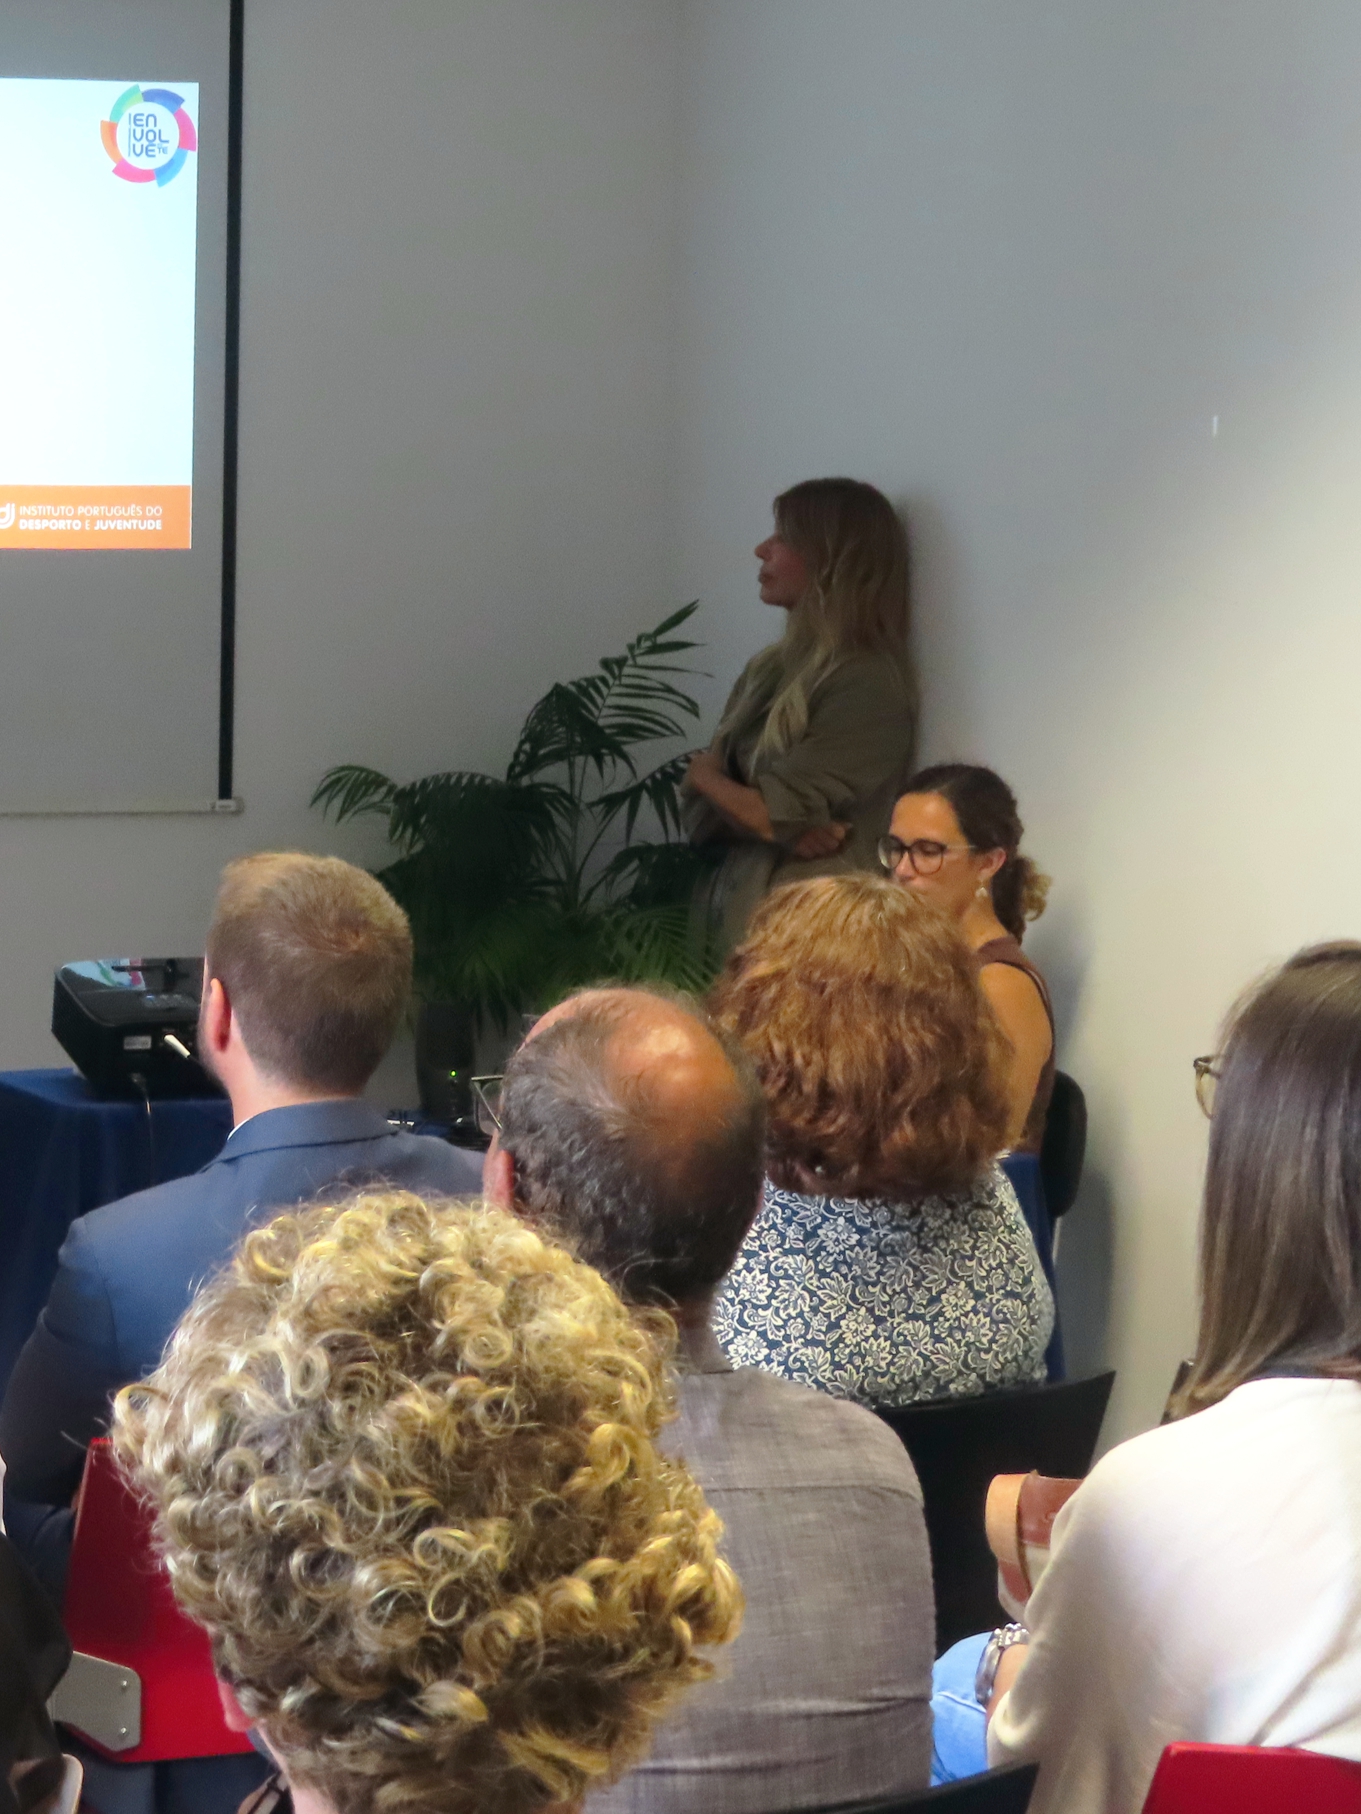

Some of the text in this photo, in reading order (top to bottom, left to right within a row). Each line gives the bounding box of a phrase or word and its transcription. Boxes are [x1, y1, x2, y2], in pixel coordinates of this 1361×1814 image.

[19, 505, 75, 517] INSTITUTO
[77, 503, 143, 517] PORTUGUÊS
[145, 506, 163, 517] DO
[19, 519, 163, 531] DESPORTO E JUVENTUDE
